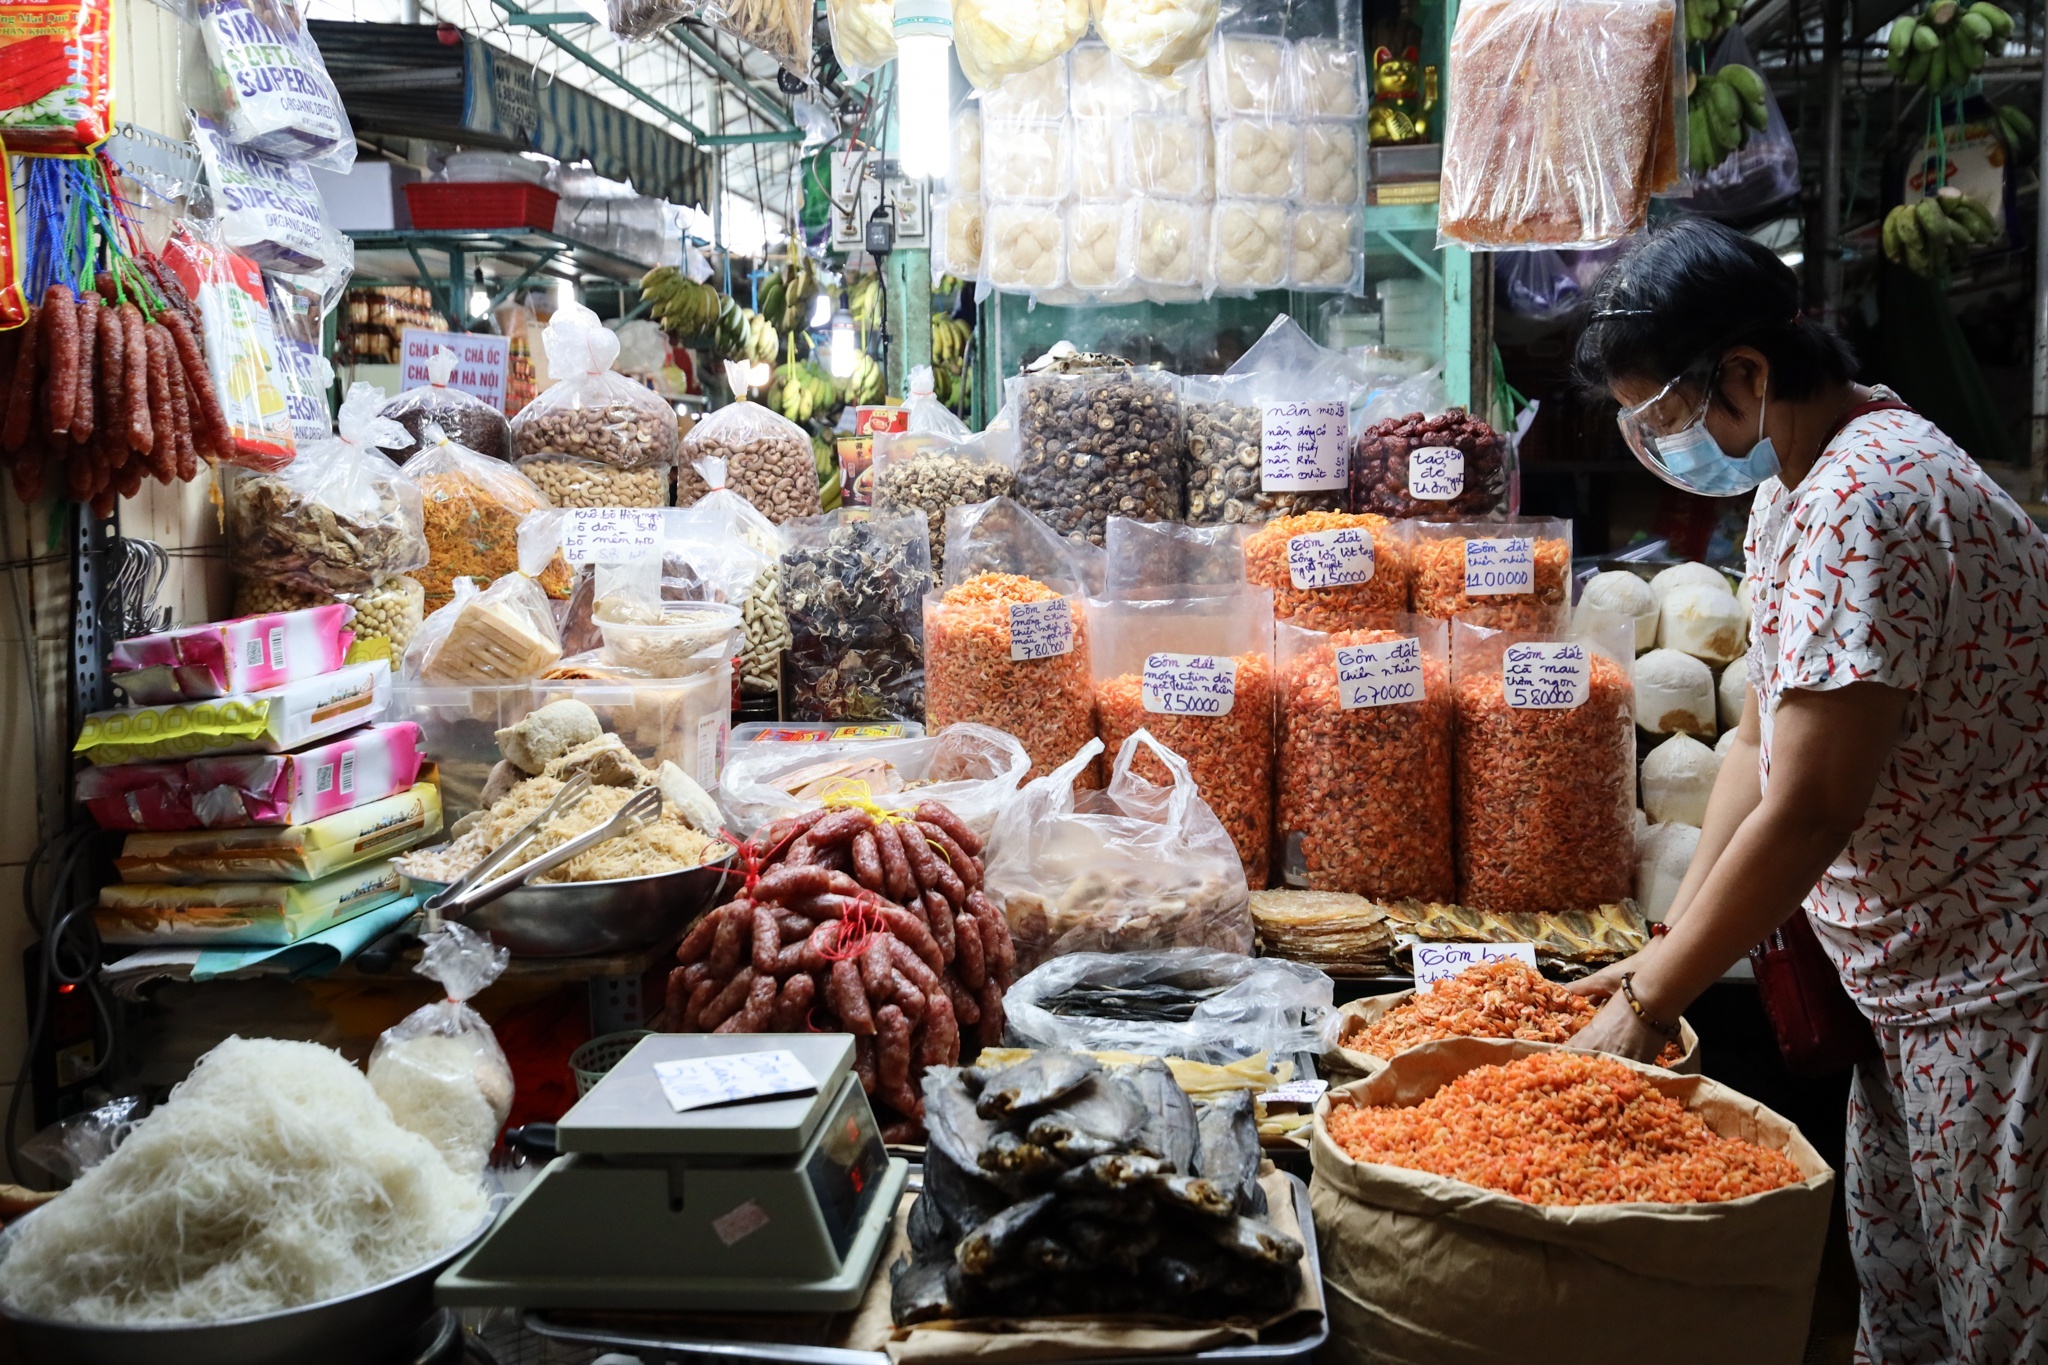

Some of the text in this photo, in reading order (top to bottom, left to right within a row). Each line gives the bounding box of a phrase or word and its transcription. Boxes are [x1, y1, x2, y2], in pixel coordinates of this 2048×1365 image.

[280, 97, 315, 116] ORGANIC
[409, 339, 429, 358] CHẢ
[465, 344, 484, 364] CHẢ
[487, 346, 500, 365] ỐC
[462, 367, 476, 386] HÀ
[480, 370, 499, 391] NỘI
[1444, 450, 1462, 461] 150
[1334, 468, 1346, 479] 50
[1163, 693, 1220, 713] 850000
[1353, 683, 1415, 704] 670000
[1511, 689, 1574, 706] 580000
